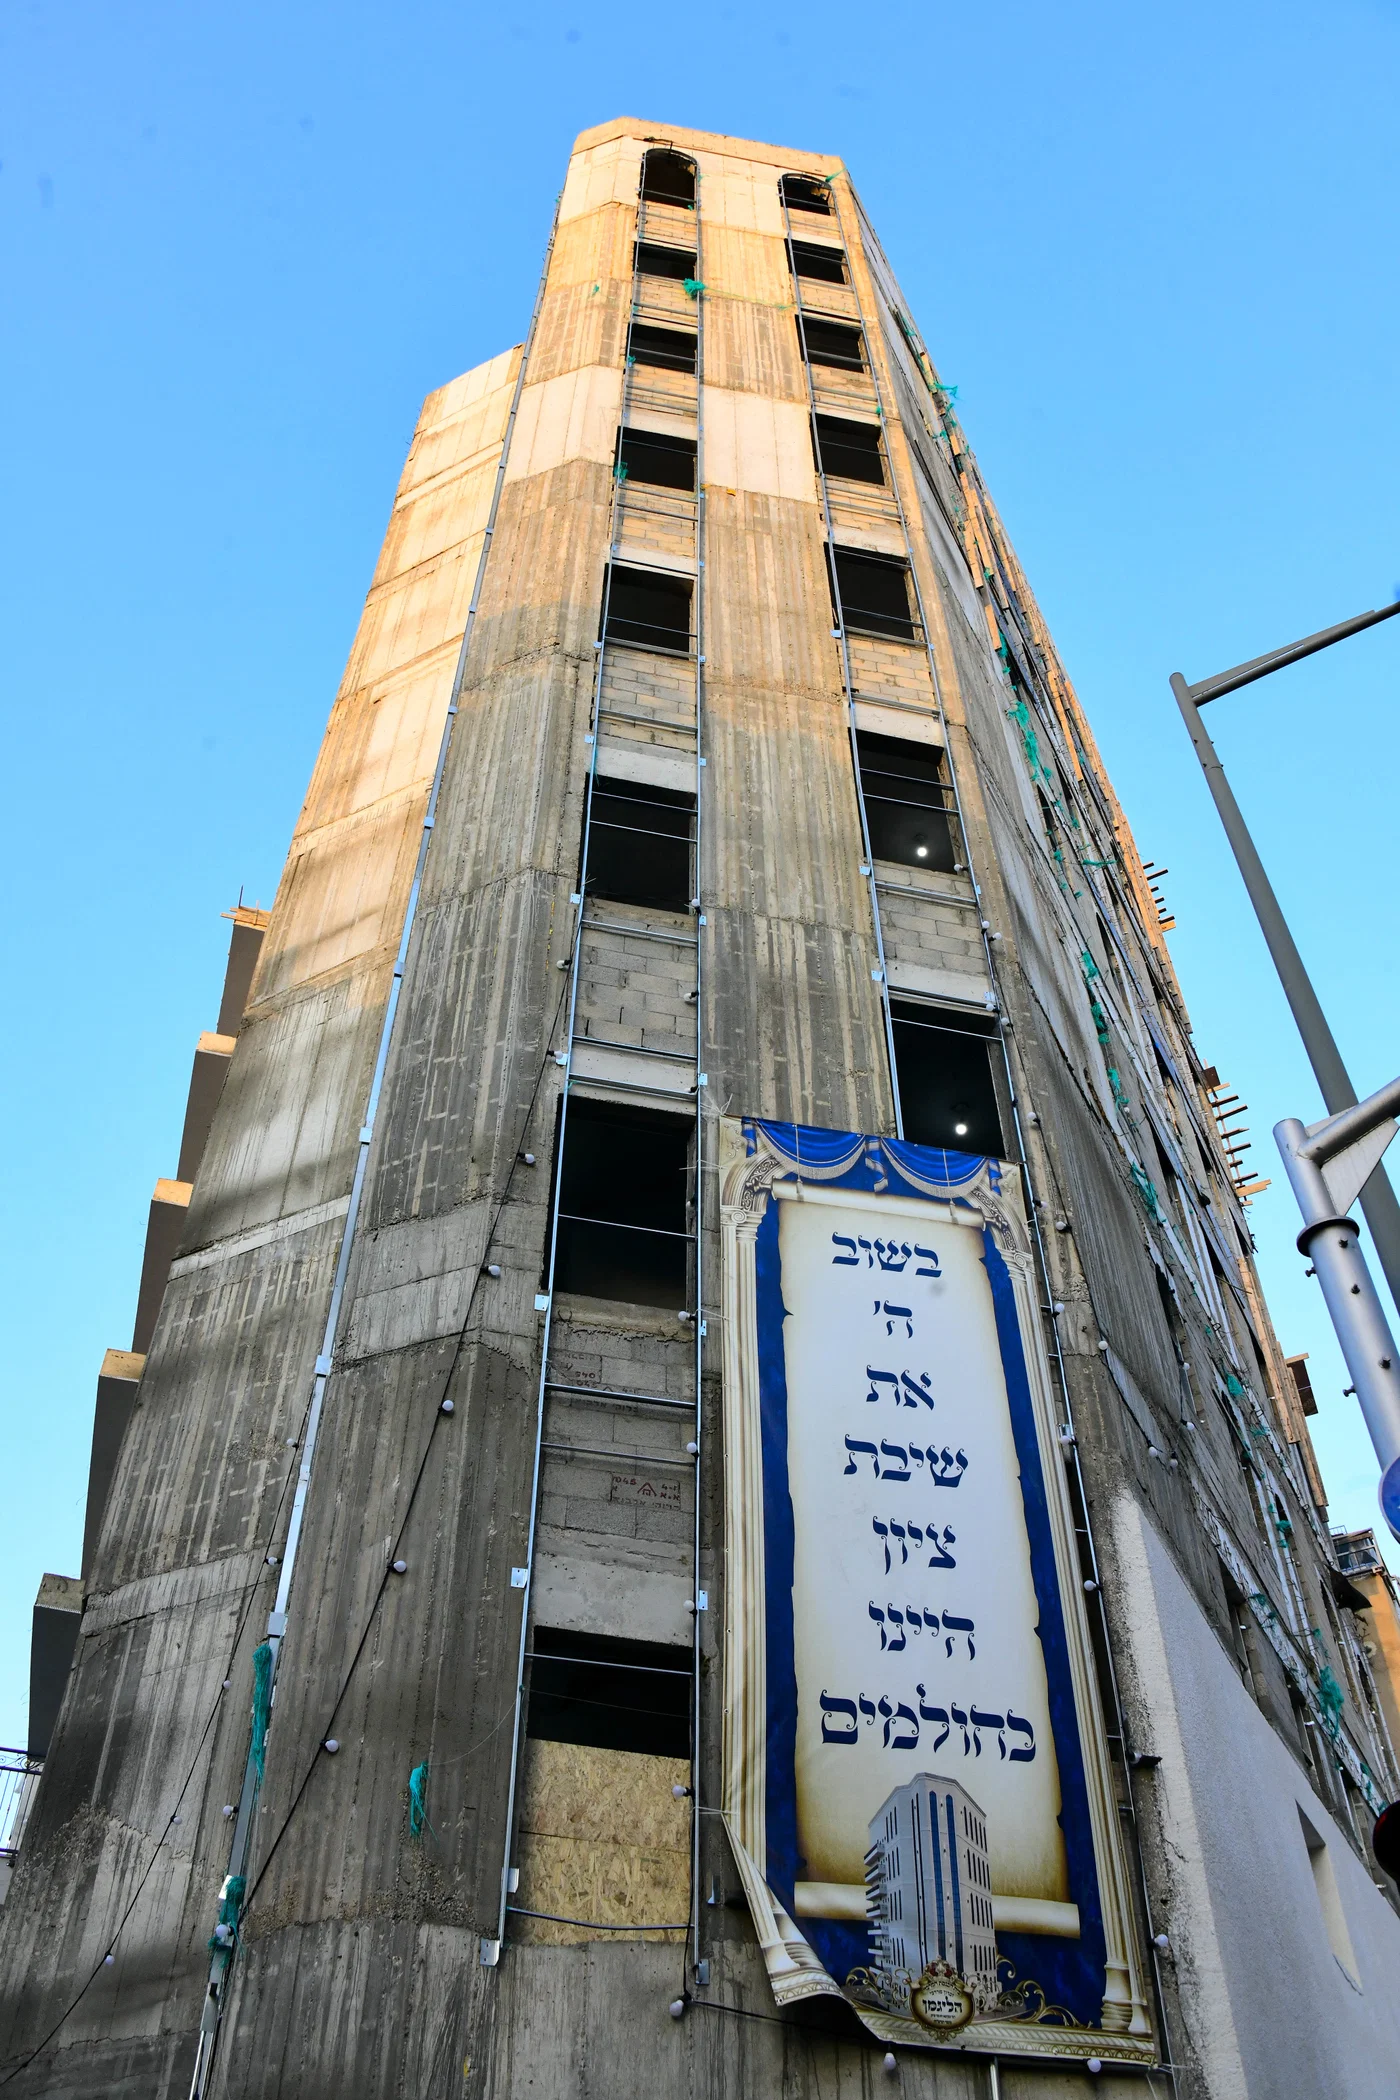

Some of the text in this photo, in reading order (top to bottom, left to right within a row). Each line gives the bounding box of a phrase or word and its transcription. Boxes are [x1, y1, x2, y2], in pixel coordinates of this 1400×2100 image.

[831, 1232, 942, 1278] בשוב
[866, 1364, 935, 1411] את
[844, 1433, 969, 1488] שיבת
[872, 1515, 957, 1575] ציון
[868, 1600, 976, 1661] היינו
[819, 1683, 1037, 1763] כחולמים
[922, 1996, 963, 2014] הליגמן
